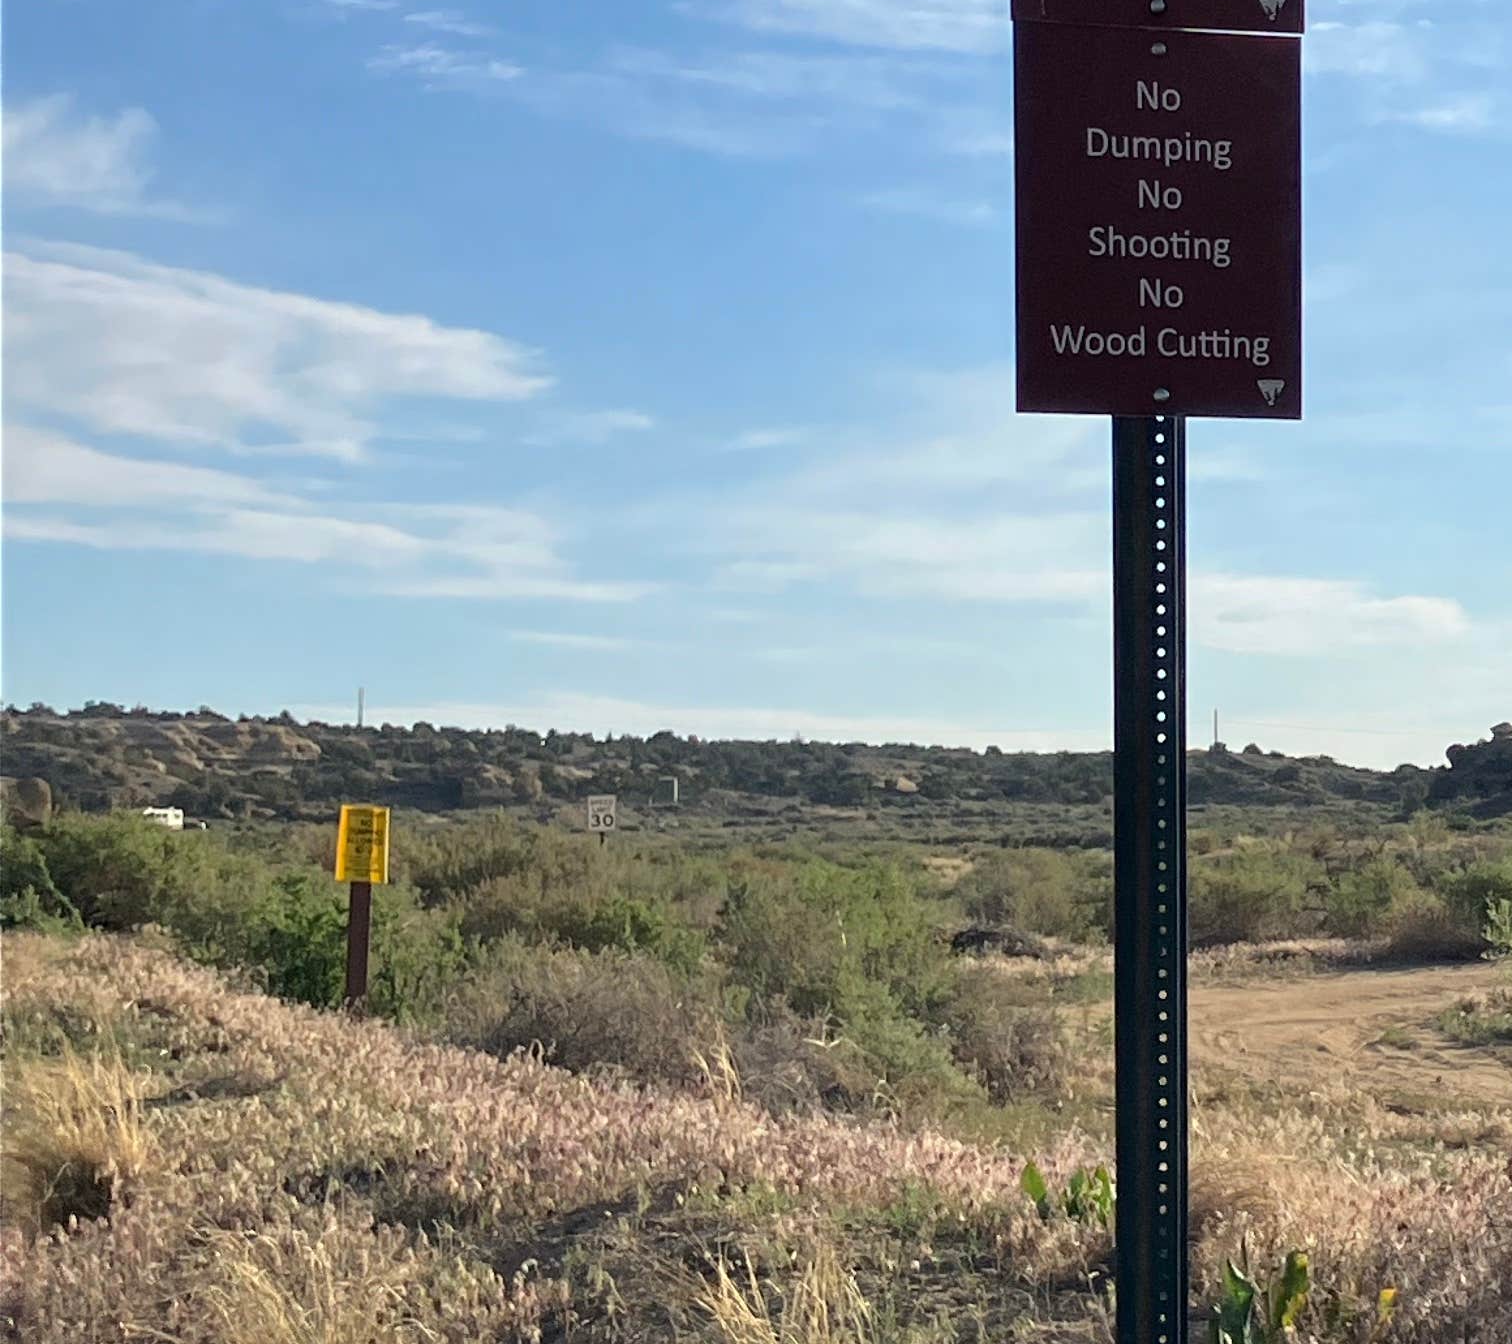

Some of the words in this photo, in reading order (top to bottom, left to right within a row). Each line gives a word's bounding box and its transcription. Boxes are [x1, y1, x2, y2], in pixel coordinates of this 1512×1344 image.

[1136, 80, 1182, 112] No
[1086, 127, 1233, 170] Dumping
[1138, 179, 1182, 210] No
[1088, 226, 1231, 268] Shooting
[1139, 278, 1184, 308] No
[1050, 324, 1145, 357] Wood
[1157, 328, 1270, 366] Cutting
[591, 814, 614, 827] 30
